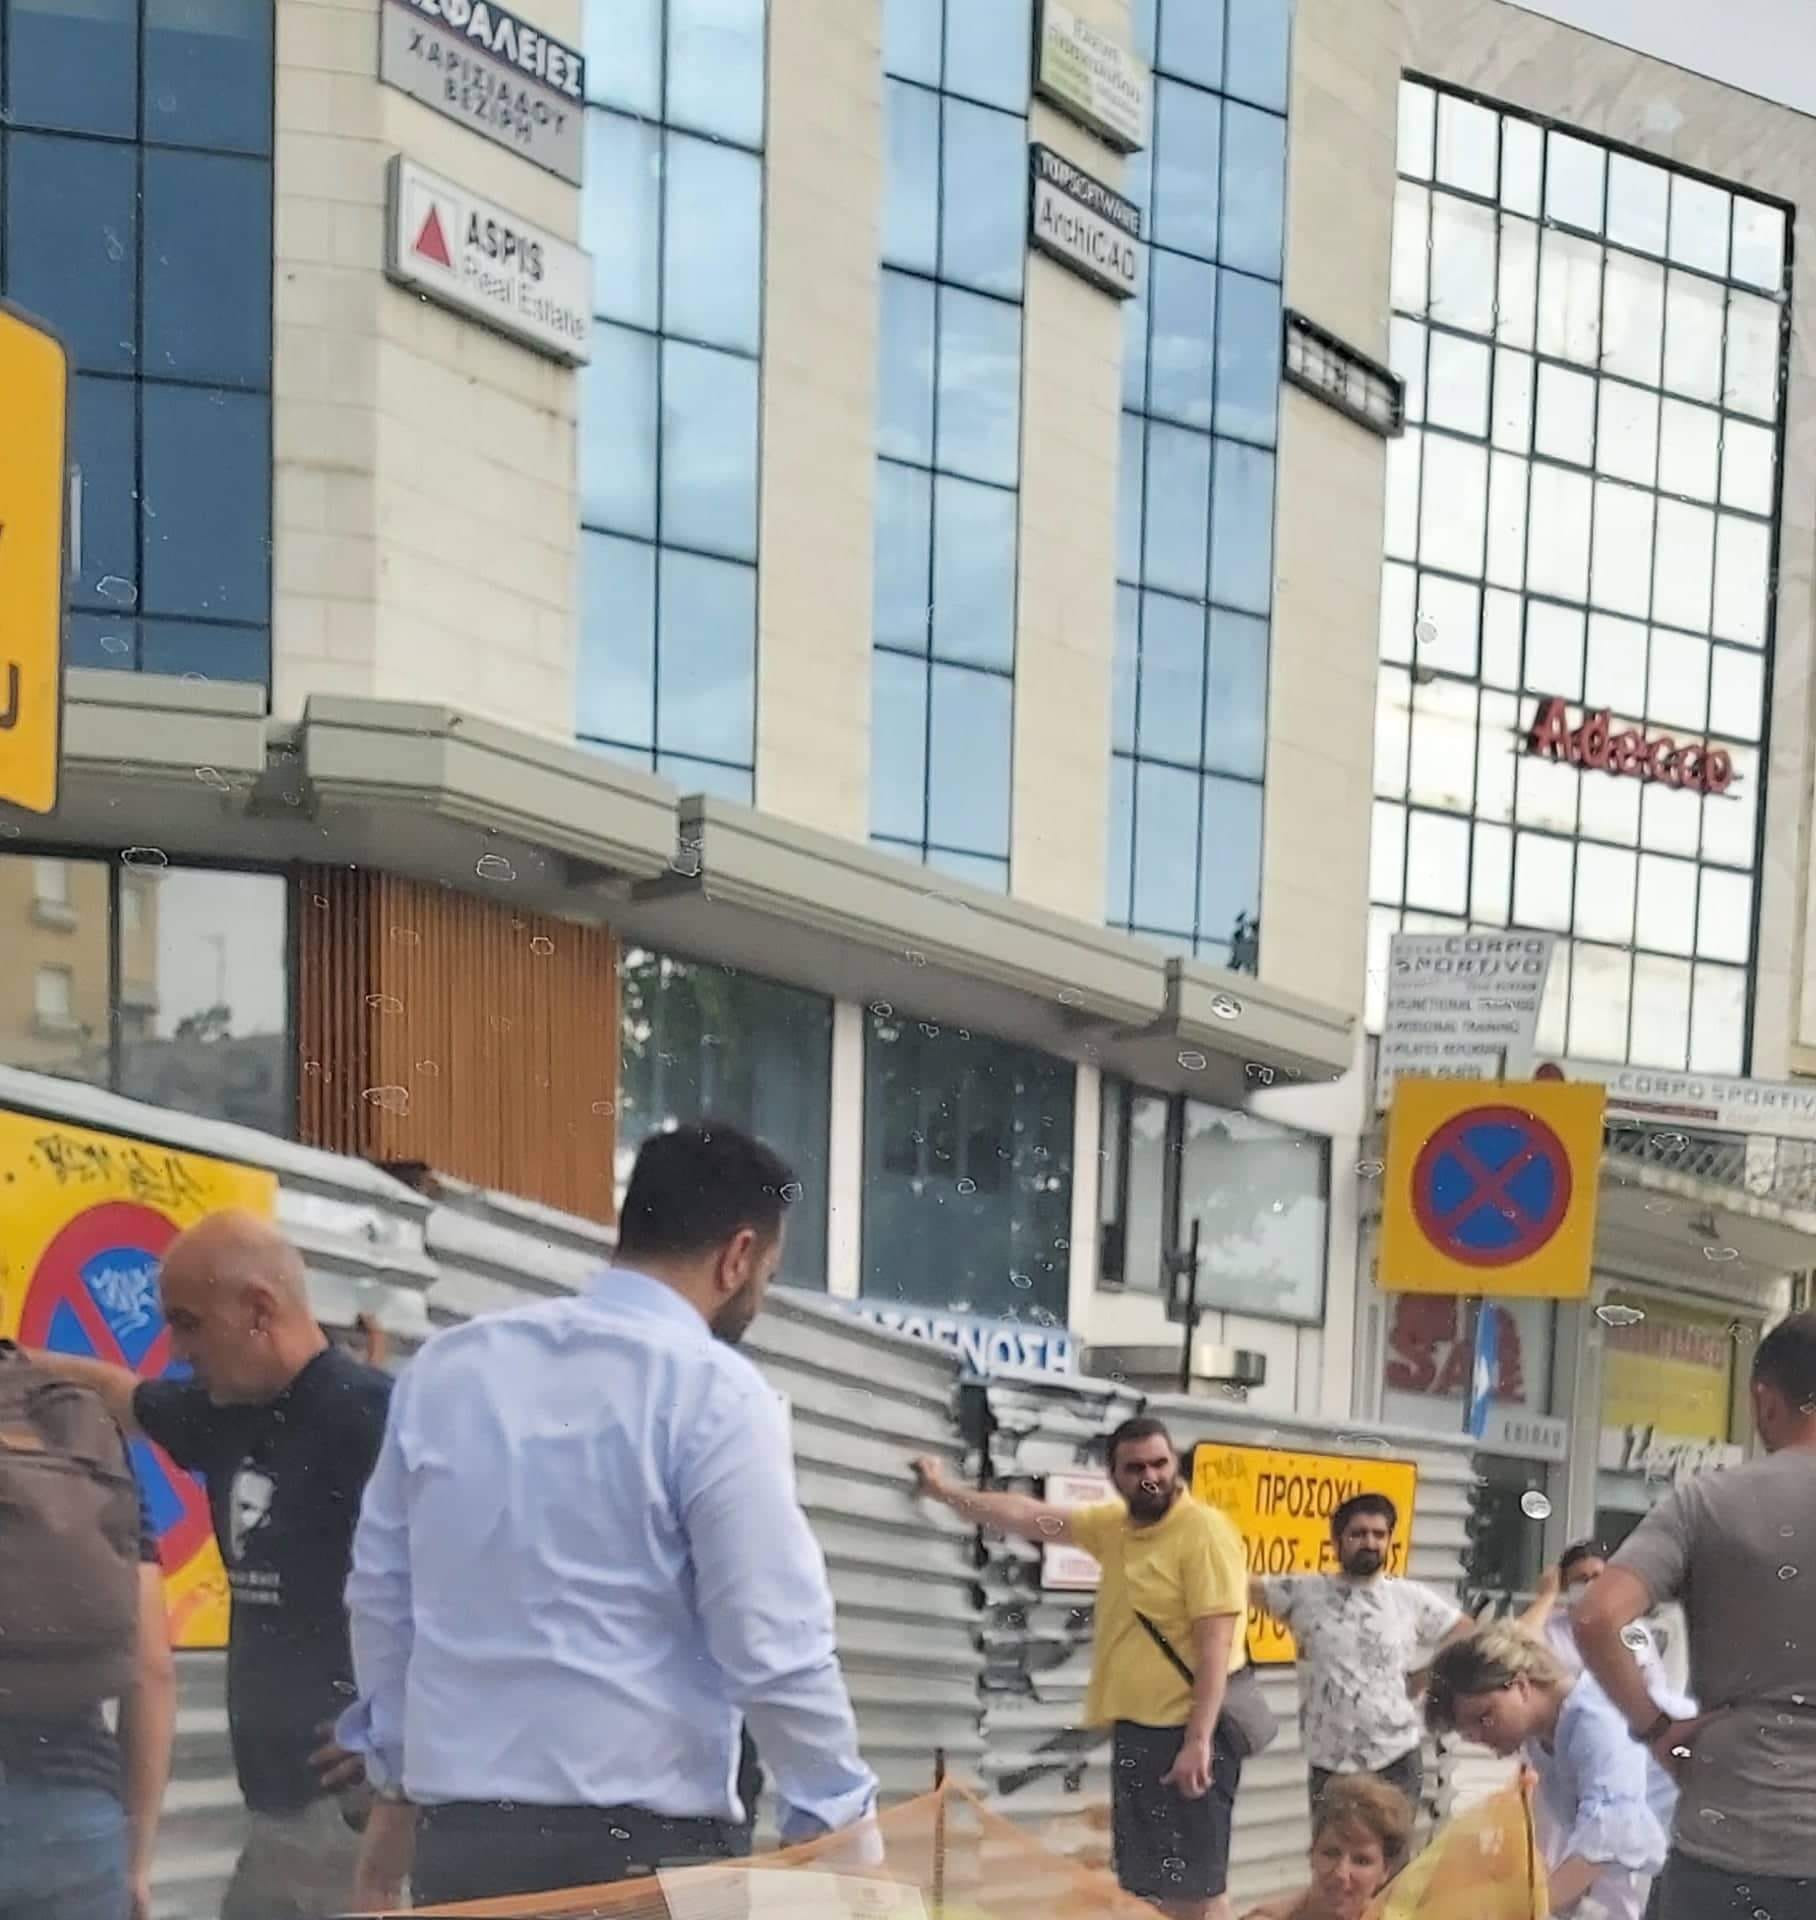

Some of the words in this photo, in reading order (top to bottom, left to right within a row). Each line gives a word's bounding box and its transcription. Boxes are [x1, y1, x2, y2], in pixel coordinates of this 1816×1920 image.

[466, 211, 543, 282] ASPIS
[1041, 197, 1135, 280] ArchiCAD
[463, 255, 511, 304] Real
[518, 281, 585, 341] Estate
[1528, 697, 1731, 794] Adecco
[1395, 957, 1541, 976] SPORTIVO
[1445, 937, 1544, 954] CORPO
[1618, 1072, 1704, 1099] CORPO
